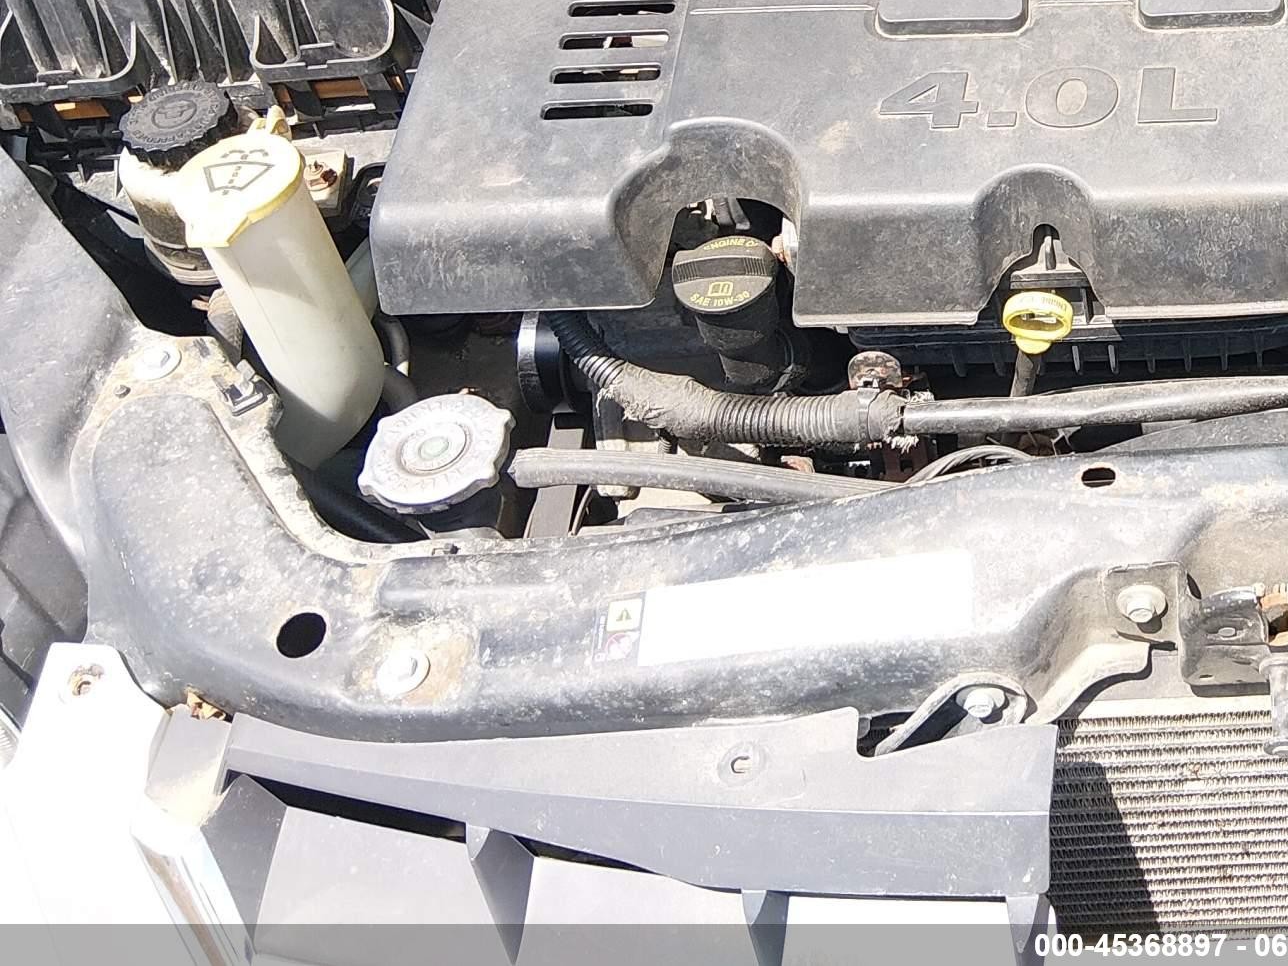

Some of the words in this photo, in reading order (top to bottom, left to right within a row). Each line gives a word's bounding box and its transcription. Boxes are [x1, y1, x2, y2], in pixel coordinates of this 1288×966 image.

[877, 66, 1219, 130] 4.0L
[703, 238, 746, 250] ENGINE
[690, 293, 711, 307] SAE
[713, 290, 750, 307] 10W-30
